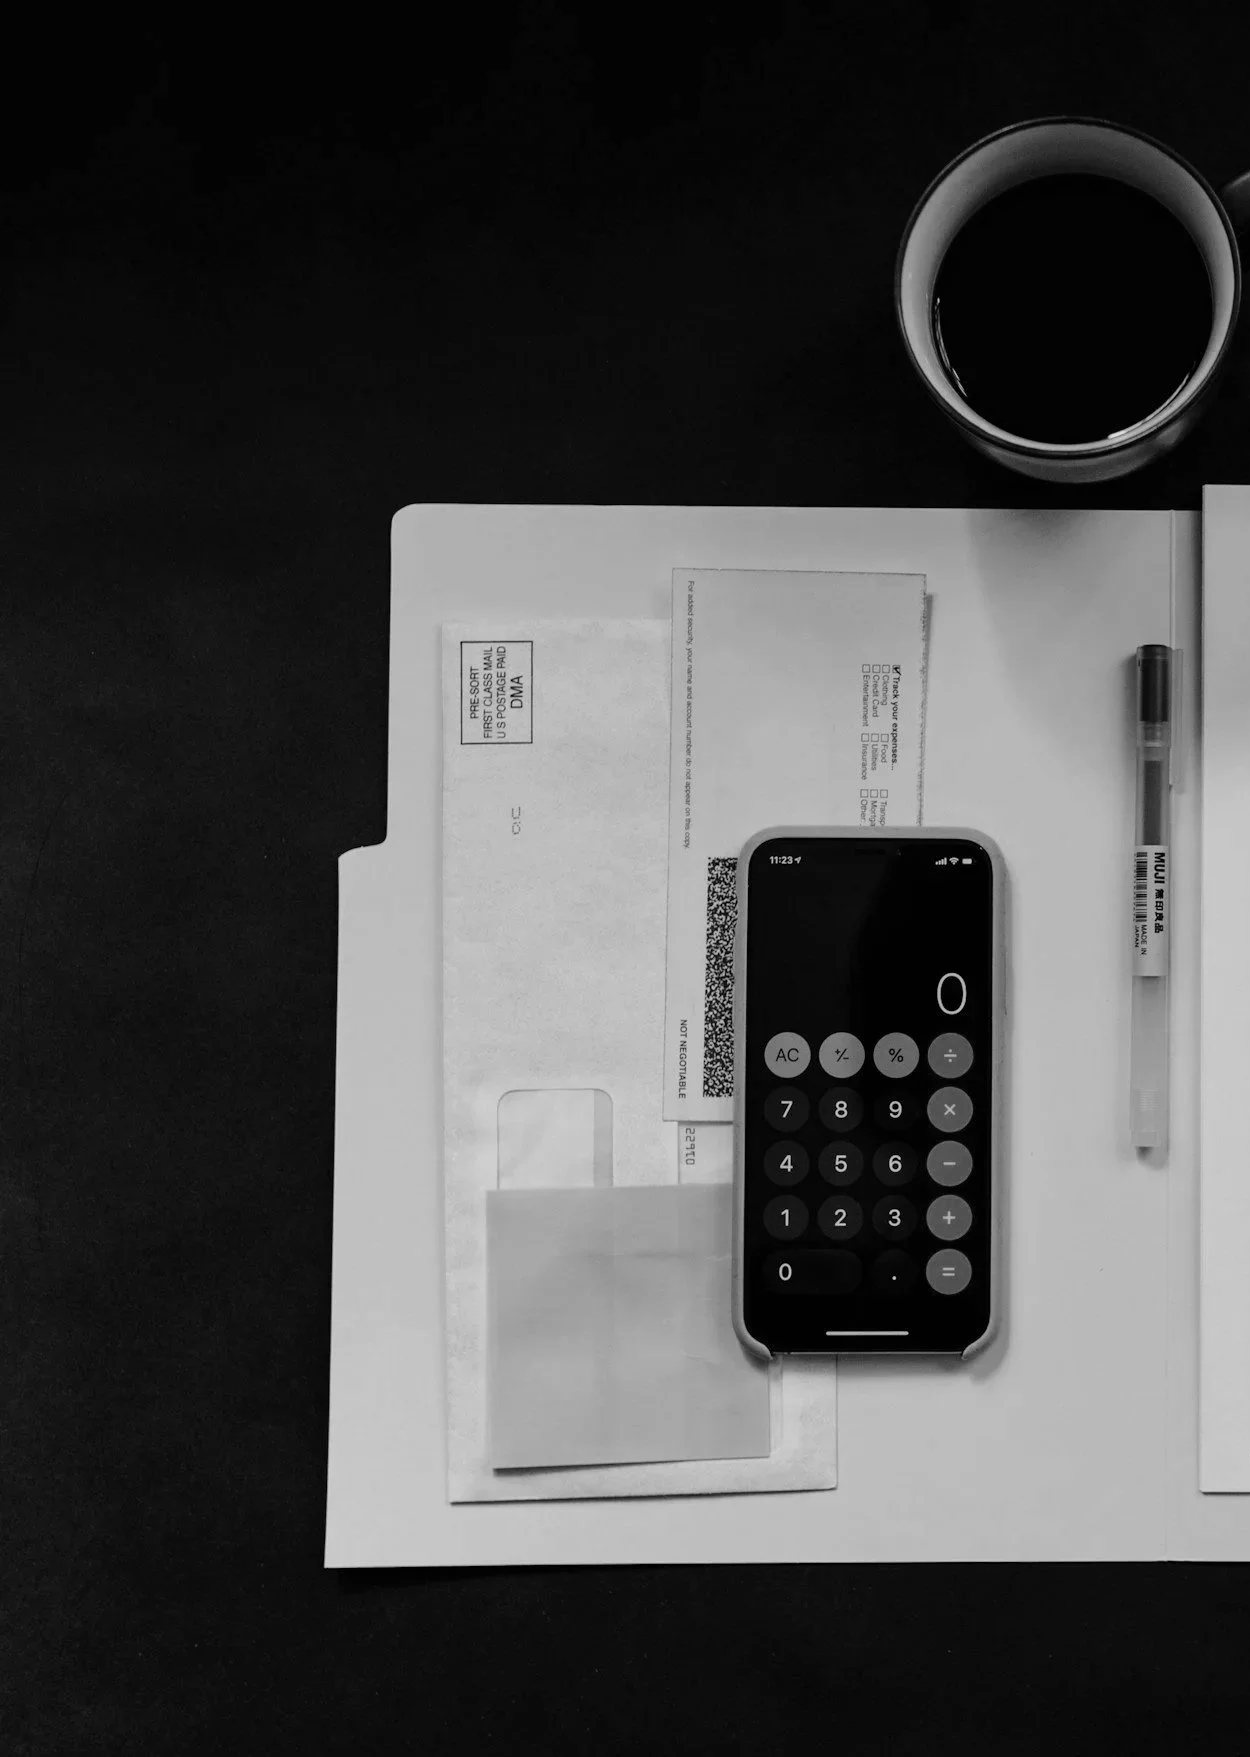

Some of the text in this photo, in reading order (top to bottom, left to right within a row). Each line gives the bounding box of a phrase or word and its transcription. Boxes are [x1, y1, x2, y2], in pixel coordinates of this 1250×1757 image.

[687, 580, 695, 593] For
[687, 593, 695, 616] added
[685, 647, 693, 663] your
[469, 666, 480, 719] PRE-SORT
[483, 646, 493, 739] FIRST CLASS MAIL
[496, 646, 507, 739] U S POSTAGE PAID
[509, 675, 523, 709] DMA
[872, 674, 880, 718] Credit Card
[880, 674, 890, 706] Clothing
[892, 676, 901, 699] Track
[862, 674, 871, 727] Entertainment
[890, 701, 899, 721] your
[685, 729, 693, 757] number
[685, 757, 692, 767] do
[860, 743, 869, 781] Insurance
[871, 743, 879, 771] Utilities
[880, 744, 889, 763] Food
[685, 807, 691, 817] on
[769, 855, 793, 864] 11:23
[1154, 852, 1166, 934] MUJI 無印良品
[1140, 924, 1148, 956] MADE IN
[937, 972, 967, 1015] 0
[678, 1019, 688, 1099] NOT NEGOTIABLE
[775, 1048, 799, 1062] AC
[888, 1048, 904, 1063] %
[781, 1100, 793, 1118] 7
[835, 1100, 848, 1118] 8
[889, 1101, 902, 1118] 9
[780, 1155, 793, 1172] 4
[835, 1155, 847, 1172] 5
[889, 1155, 902, 1172] 6
[781, 1209, 789, 1226] 1
[834, 1209, 846, 1226] 2
[888, 1209, 901, 1227] 3
[779, 1263, 792, 1281] 0
